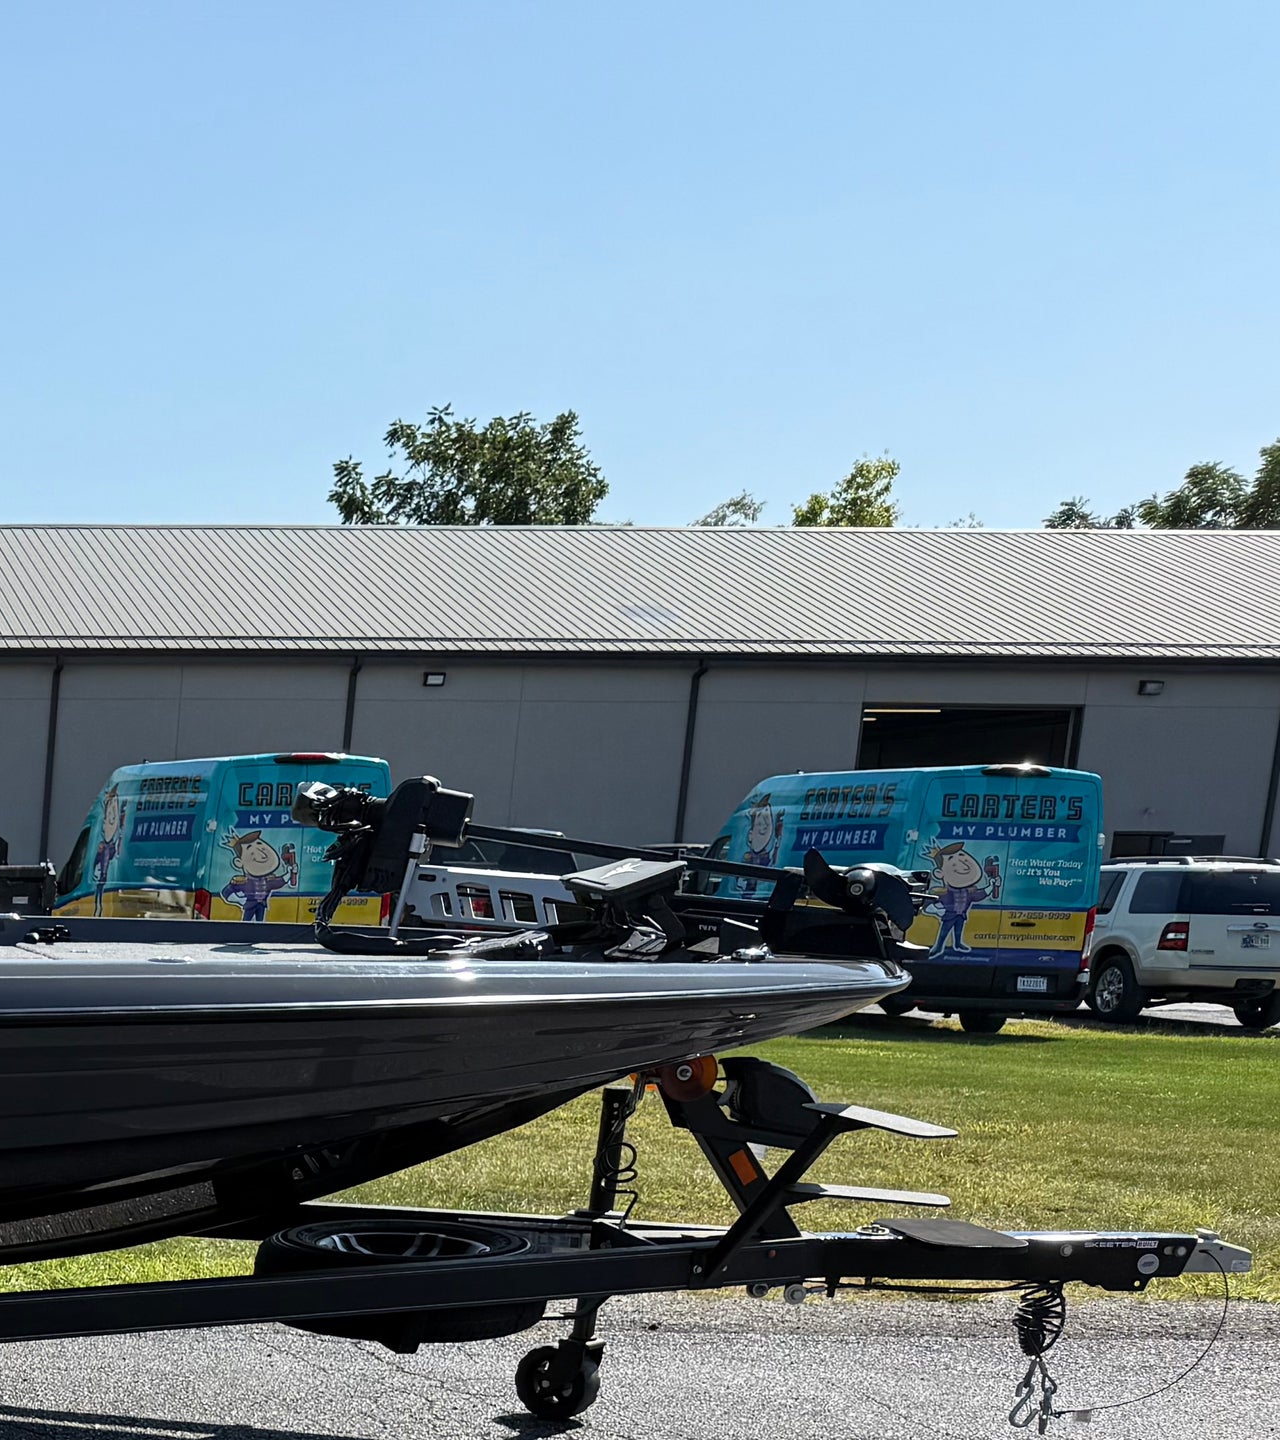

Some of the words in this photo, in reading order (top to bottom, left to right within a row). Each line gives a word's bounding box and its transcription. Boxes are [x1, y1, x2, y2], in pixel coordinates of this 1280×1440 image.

[801, 782, 899, 820] CARTER'S
[942, 793, 1083, 821] CARTER'S
[249, 813, 273, 825] MY
[149, 820, 188, 836] PLUMBER
[952, 825, 977, 836] MY
[985, 826, 1067, 839] PLUMBER
[801, 831, 819, 846] MY
[821, 829, 877, 845] PLUMBER
[1029, 859, 1056, 868] Water
[1057, 860, 1084, 870] Today
[1026, 868, 1042, 876] It's
[1043, 869, 1061, 877] You
[1039, 877, 1053, 886] We
